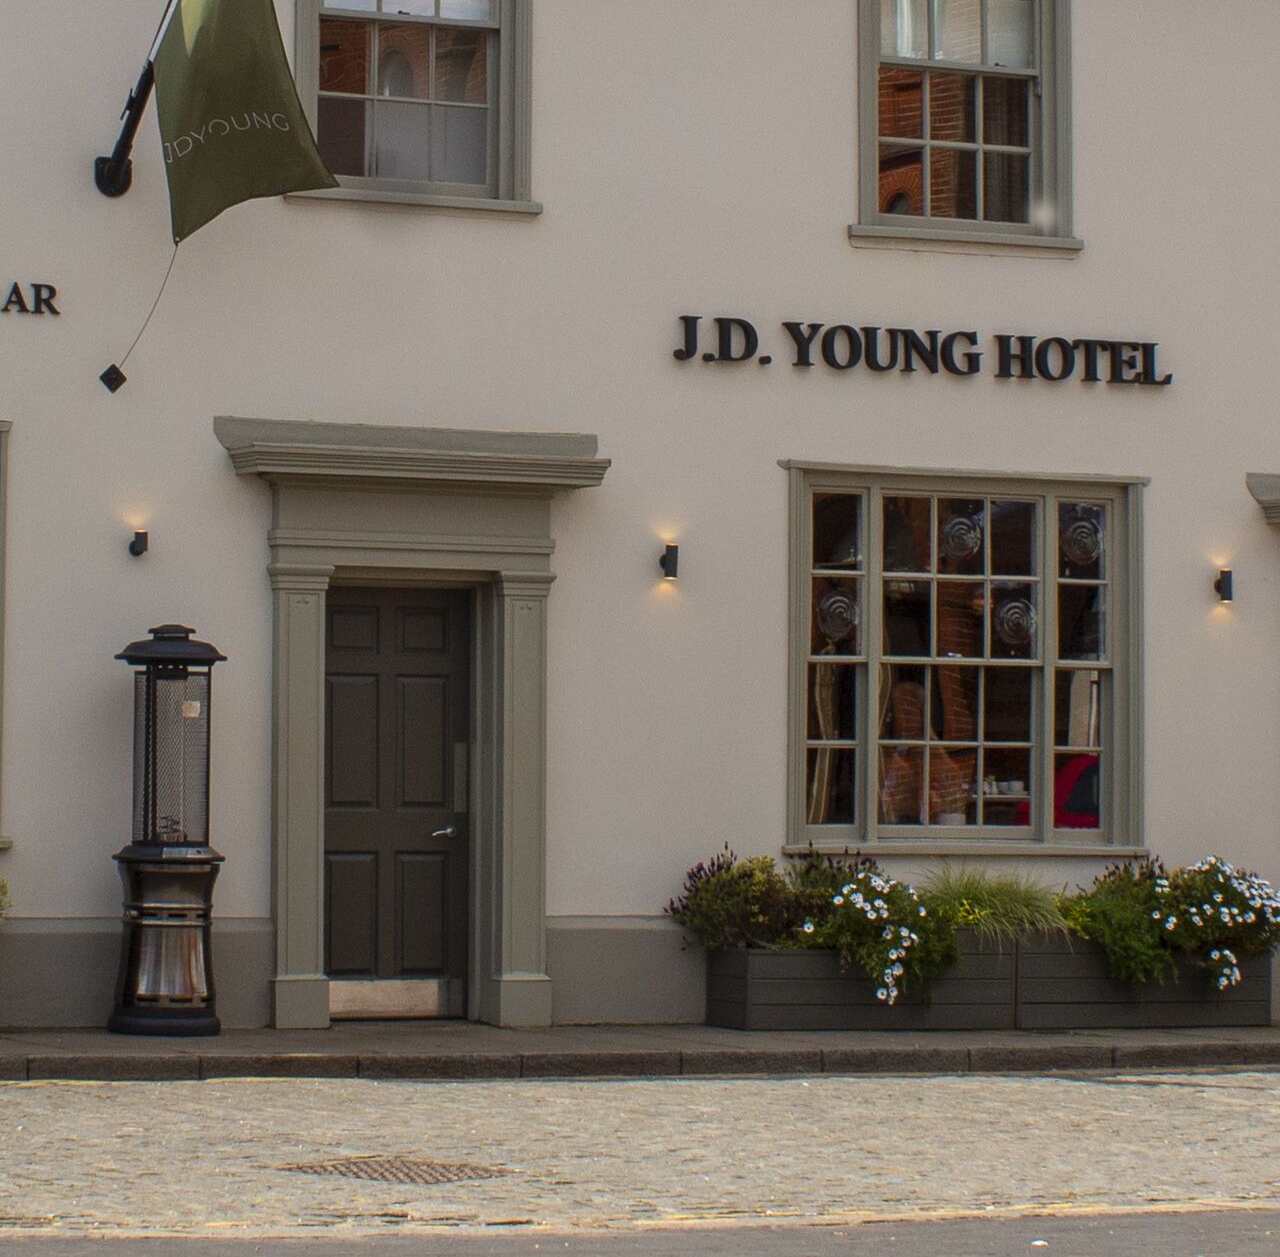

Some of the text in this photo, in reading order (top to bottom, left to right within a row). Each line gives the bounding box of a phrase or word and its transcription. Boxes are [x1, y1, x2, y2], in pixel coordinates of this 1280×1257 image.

[164, 111, 290, 164] JDYOUNG
[672, 315, 1173, 387] J.D. YOUNG HOTEL
